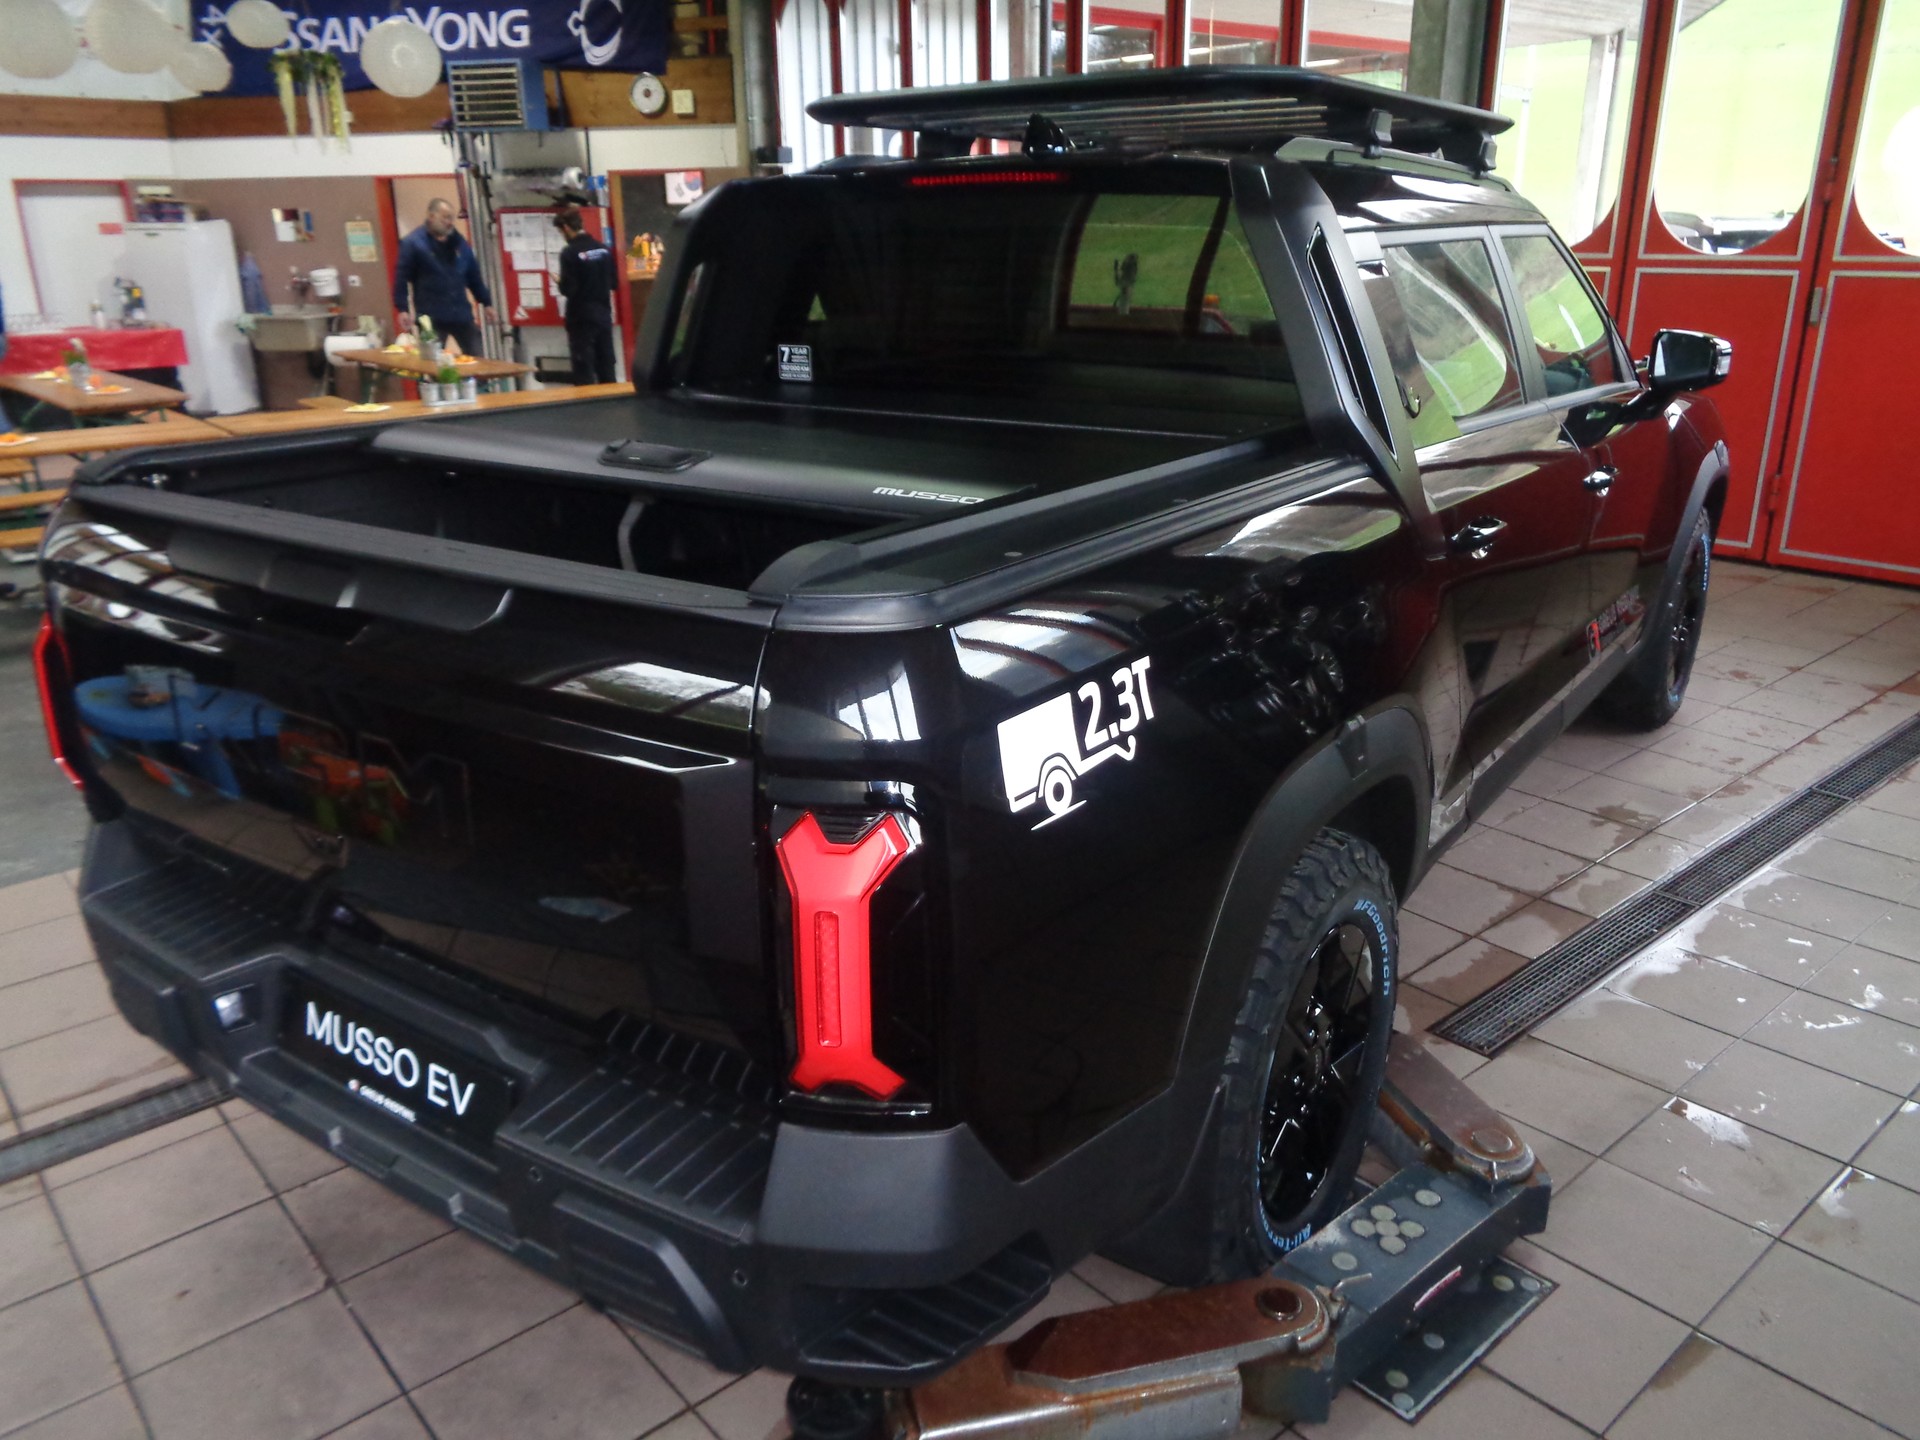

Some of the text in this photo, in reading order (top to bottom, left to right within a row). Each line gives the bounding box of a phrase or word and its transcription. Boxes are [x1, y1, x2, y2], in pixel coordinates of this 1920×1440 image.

[273, 6, 531, 54] SSANYONG
[780, 346, 790, 362] 7
[791, 347, 808, 355] YEAR
[872, 486, 985, 505] MUSSO
[1077, 655, 1154, 751] 2.3T
[306, 1001, 420, 1088] MUSSO
[427, 1062, 476, 1116] EV
